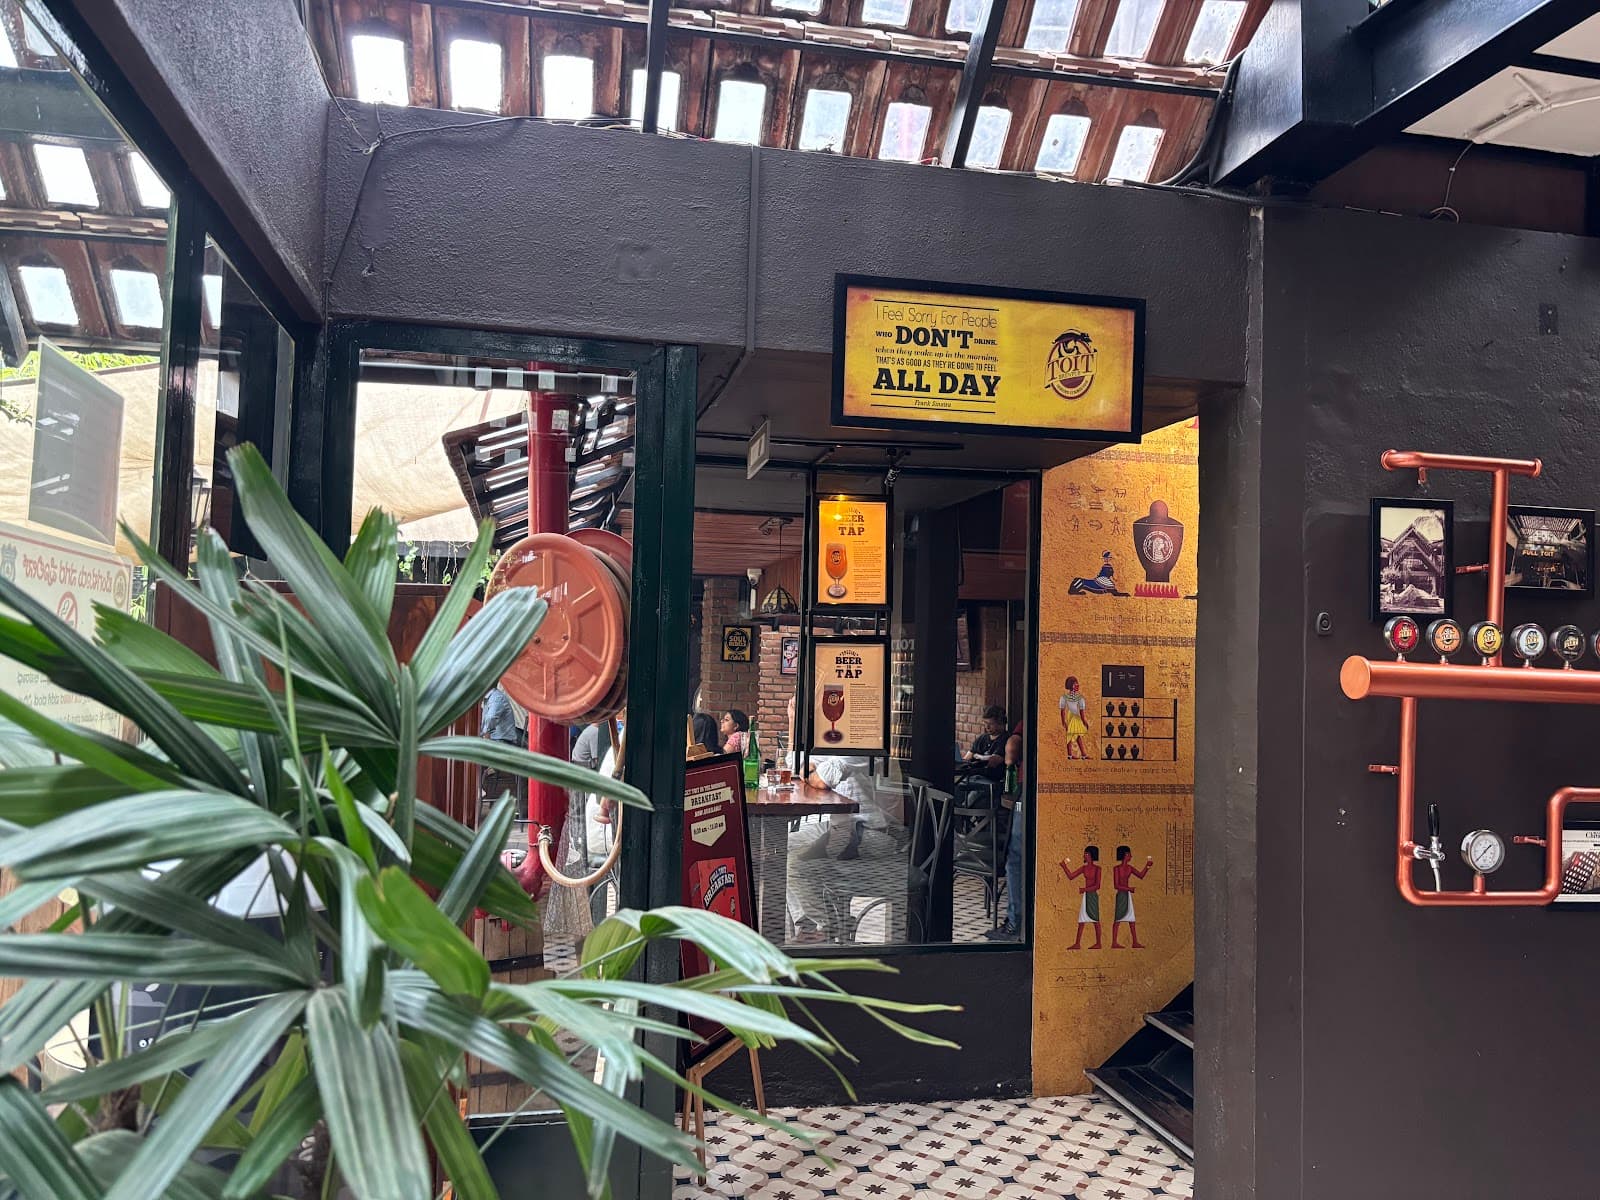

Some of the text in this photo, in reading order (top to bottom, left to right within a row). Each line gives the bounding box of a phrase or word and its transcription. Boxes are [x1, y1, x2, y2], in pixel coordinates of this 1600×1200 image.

[882, 305, 905, 321] Feel
[908, 307, 937, 327] Sorry
[941, 311, 958, 325] For
[961, 311, 998, 331] People
[875, 330, 893, 338] WHO
[895, 325, 974, 349] DON'T
[896, 347, 913, 357] they
[934, 351, 944, 359] up
[954, 351, 966, 359] the
[876, 355, 896, 365] THAT'S
[896, 357, 905, 366] AS
[905, 358, 922, 367] GOOD
[923, 359, 931, 368] AS
[956, 361, 974, 370] GOING
[975, 362, 983, 371] TO
[1048, 353, 1095, 381] TOIT
[873, 367, 1001, 397] ALL DAY
[838, 526, 865, 536] TAP
[835, 656, 862, 665] BEER
[835, 669, 863, 679] TAP
[691, 791, 722, 807] BREAKFAST
[703, 873, 735, 907] BREAKFAST
